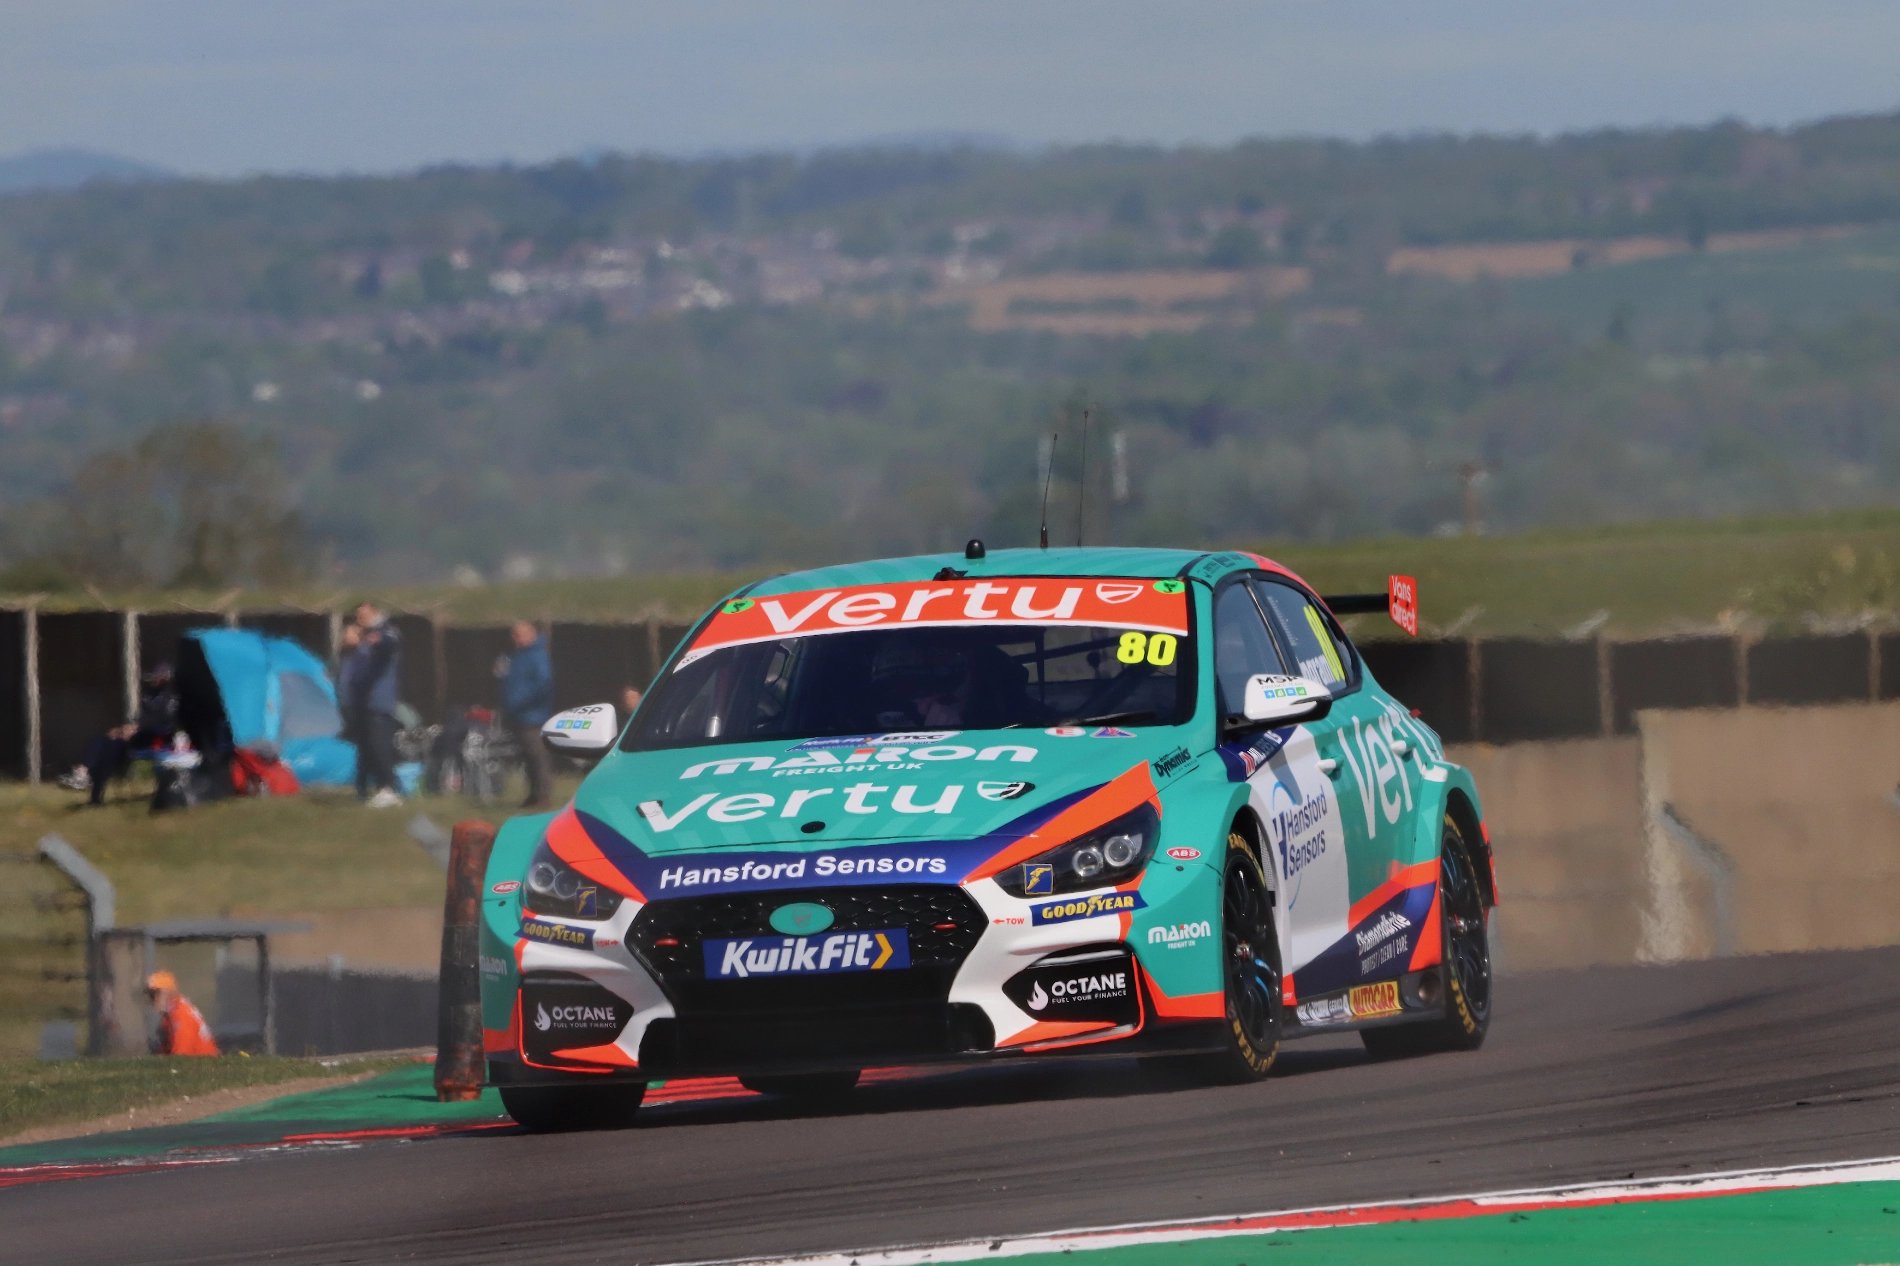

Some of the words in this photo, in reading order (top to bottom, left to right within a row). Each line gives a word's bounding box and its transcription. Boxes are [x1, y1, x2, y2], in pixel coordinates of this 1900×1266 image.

[1391, 575, 1412, 603] Vans
[1116, 632, 1177, 667] 80
[772, 764, 881, 777] FREIGHT
[887, 762, 925, 771] UK
[1286, 784, 1327, 842] Hansford
[1171, 848, 1198, 857] ABS
[1289, 829, 1326, 877] Sensors
[659, 859, 807, 889] Hansford
[815, 856, 947, 876] Sensors
[1006, 917, 1025, 925] TOW
[1051, 972, 1126, 997] OCTANE
[1072, 994, 1092, 1002] YOUR
[1094, 990, 1127, 999] FINANCE
[1353, 983, 1398, 1014] AUTOCAR
[552, 1005, 616, 1021] OCTANE
